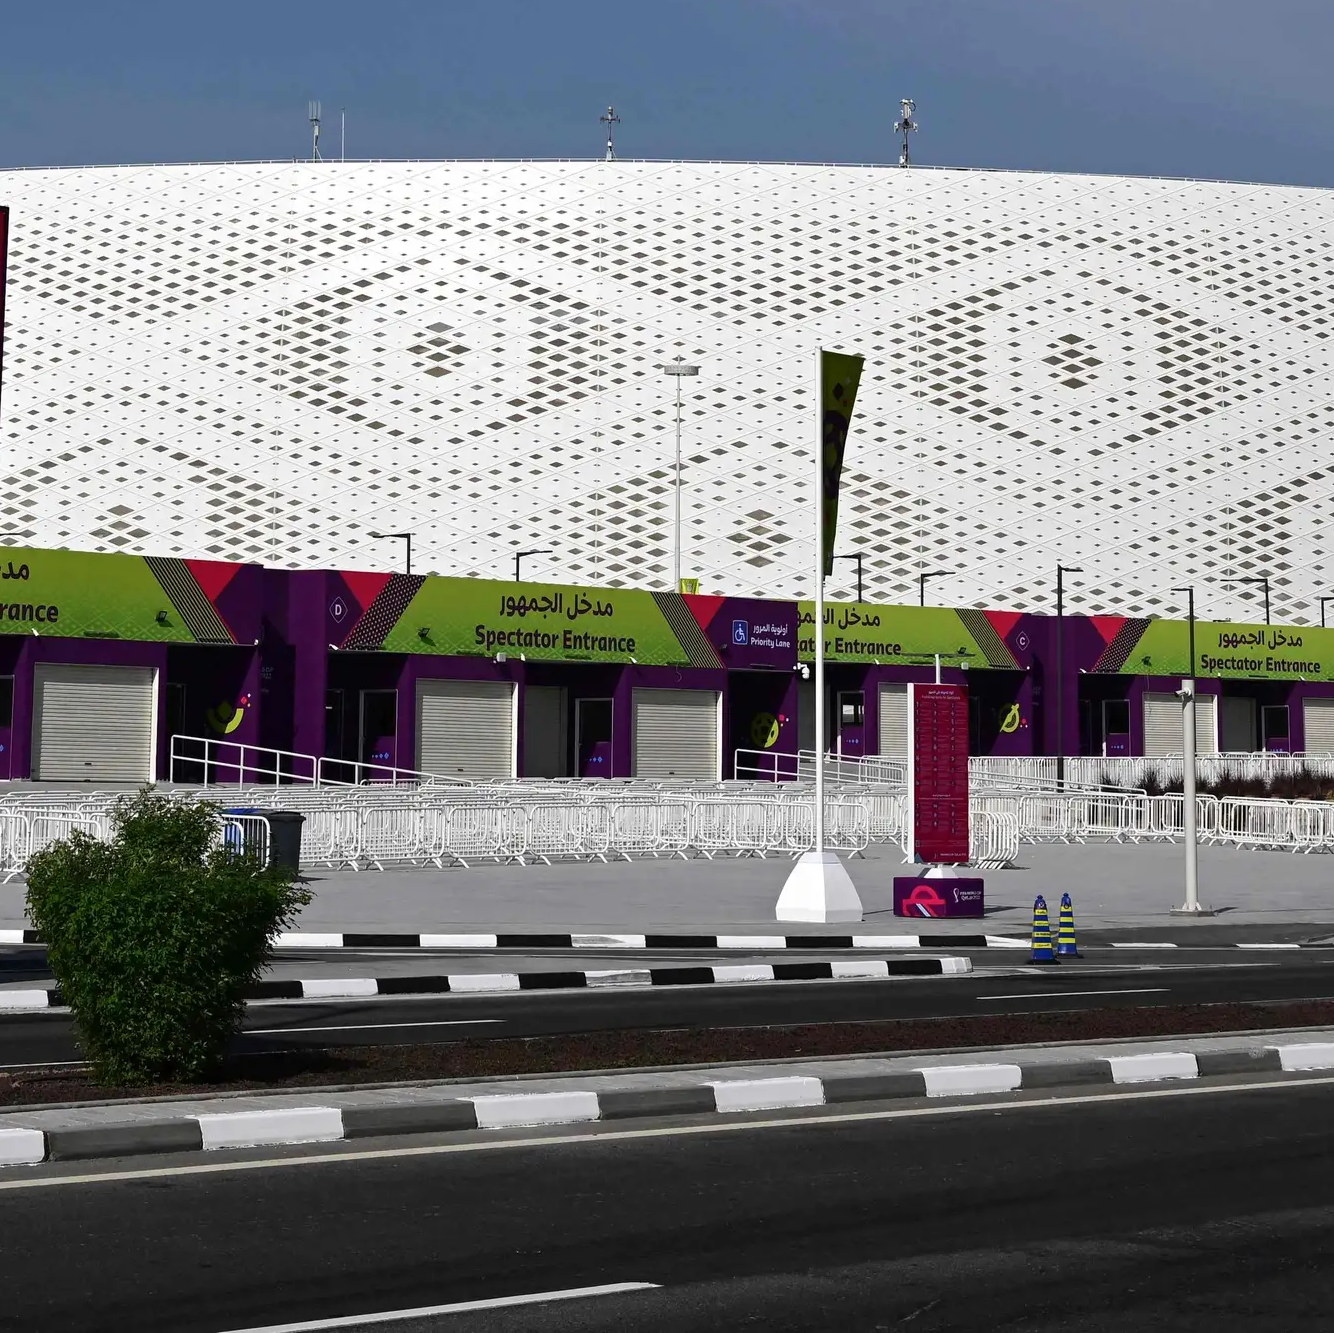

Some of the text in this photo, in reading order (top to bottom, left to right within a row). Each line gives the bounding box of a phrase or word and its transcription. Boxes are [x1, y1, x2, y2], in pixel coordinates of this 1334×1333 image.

[334, 604, 342, 616] D
[499, 592, 613, 621] مدخل الجمهور
[838, 607, 881, 630] مدخل
[753, 623, 770, 634] المرور
[474, 624, 636, 653] Spectator Entrance
[750, 637, 775, 649] Priority
[775, 639, 791, 649] Lane
[835, 637, 902, 656] Entrance
[1019, 636, 1026, 646] C
[1218, 629, 1303, 650] مدخل الجمهور
[1201, 654, 1321, 673] Spectator Entrance
